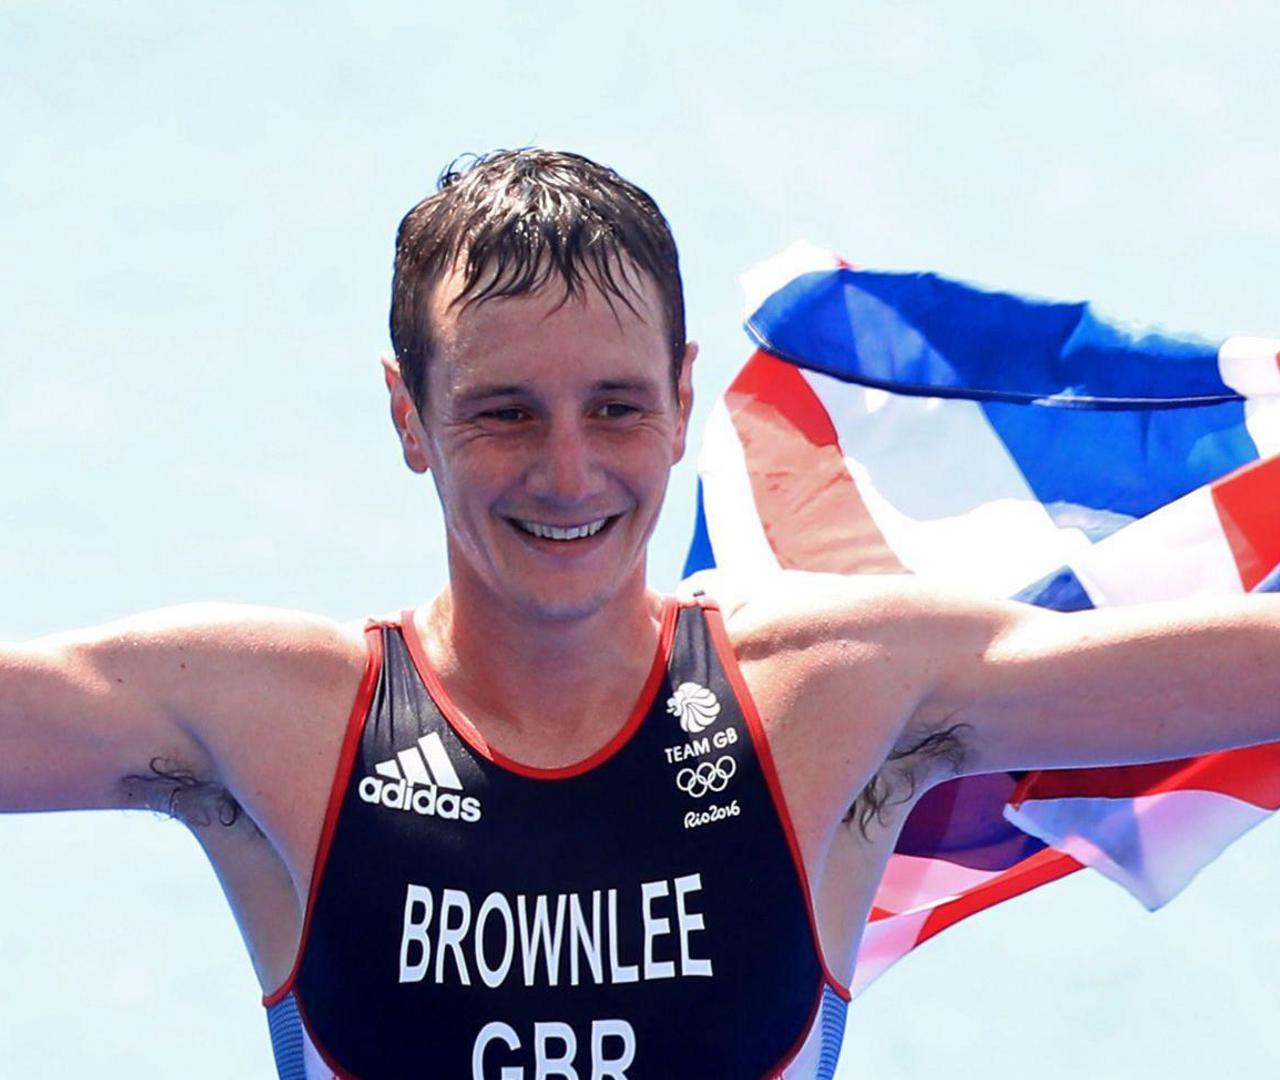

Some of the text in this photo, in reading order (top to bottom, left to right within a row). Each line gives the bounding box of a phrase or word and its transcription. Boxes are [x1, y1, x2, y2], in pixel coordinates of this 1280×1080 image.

[665, 727, 738, 763] TEAM GB
[359, 776, 481, 822] adidas
[399, 873, 713, 988] BROWNLEE
